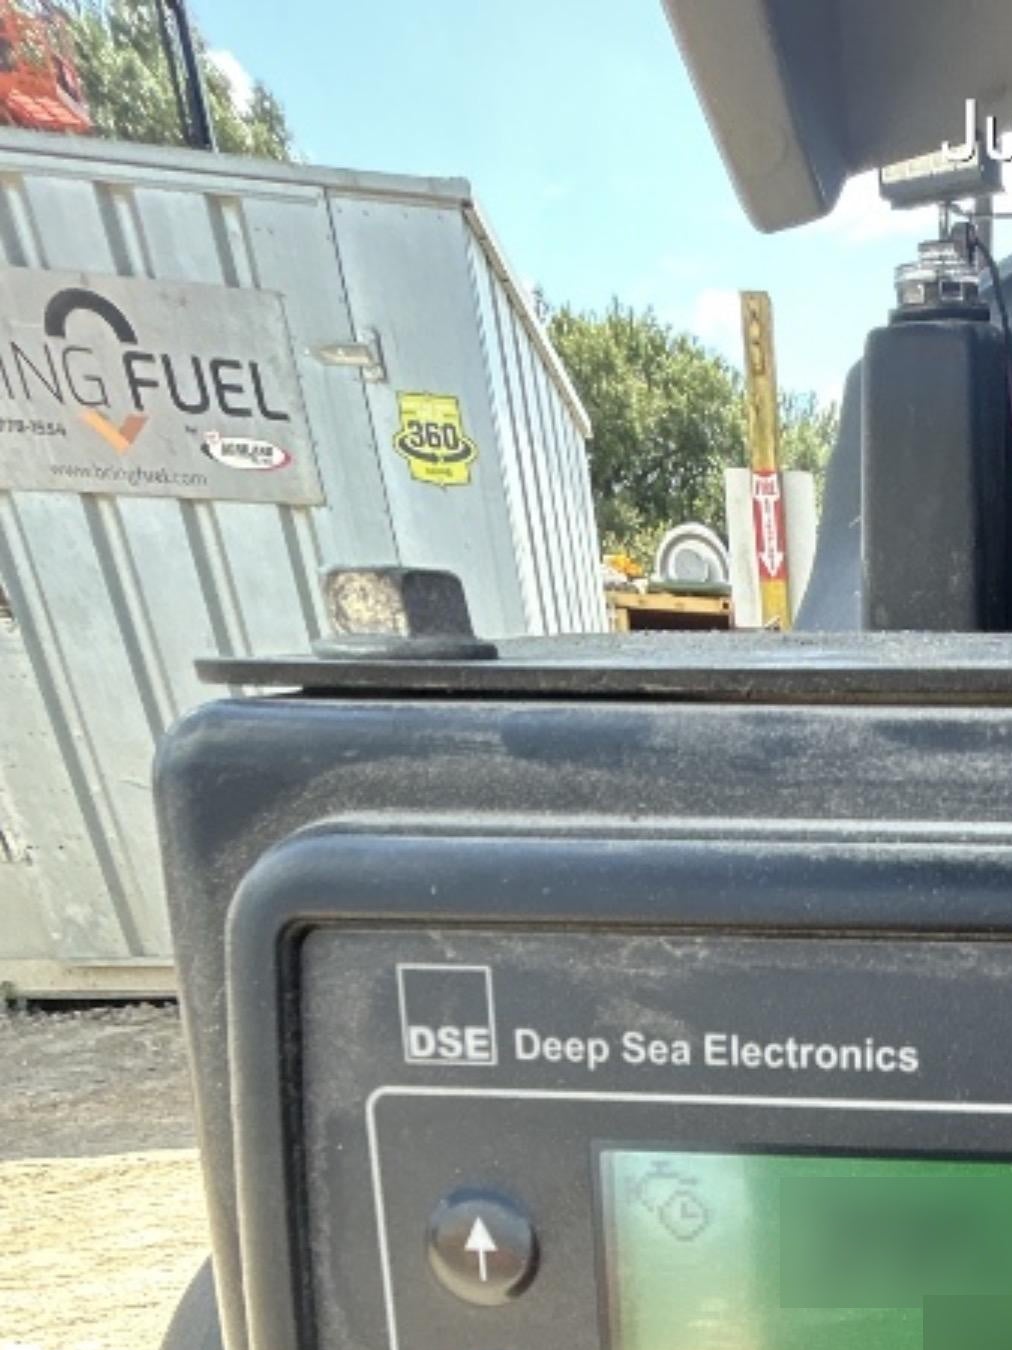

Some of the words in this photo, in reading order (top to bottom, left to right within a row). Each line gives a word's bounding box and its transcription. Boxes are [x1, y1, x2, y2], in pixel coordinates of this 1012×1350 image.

[123, 350, 290, 421] FUEL
[406, 419, 459, 450] 360
[408, 1024, 491, 1060] DSE
[514, 1026, 610, 1072] Deep
[621, 1030, 692, 1066] Sea
[703, 1033, 920, 1073] Electronics
